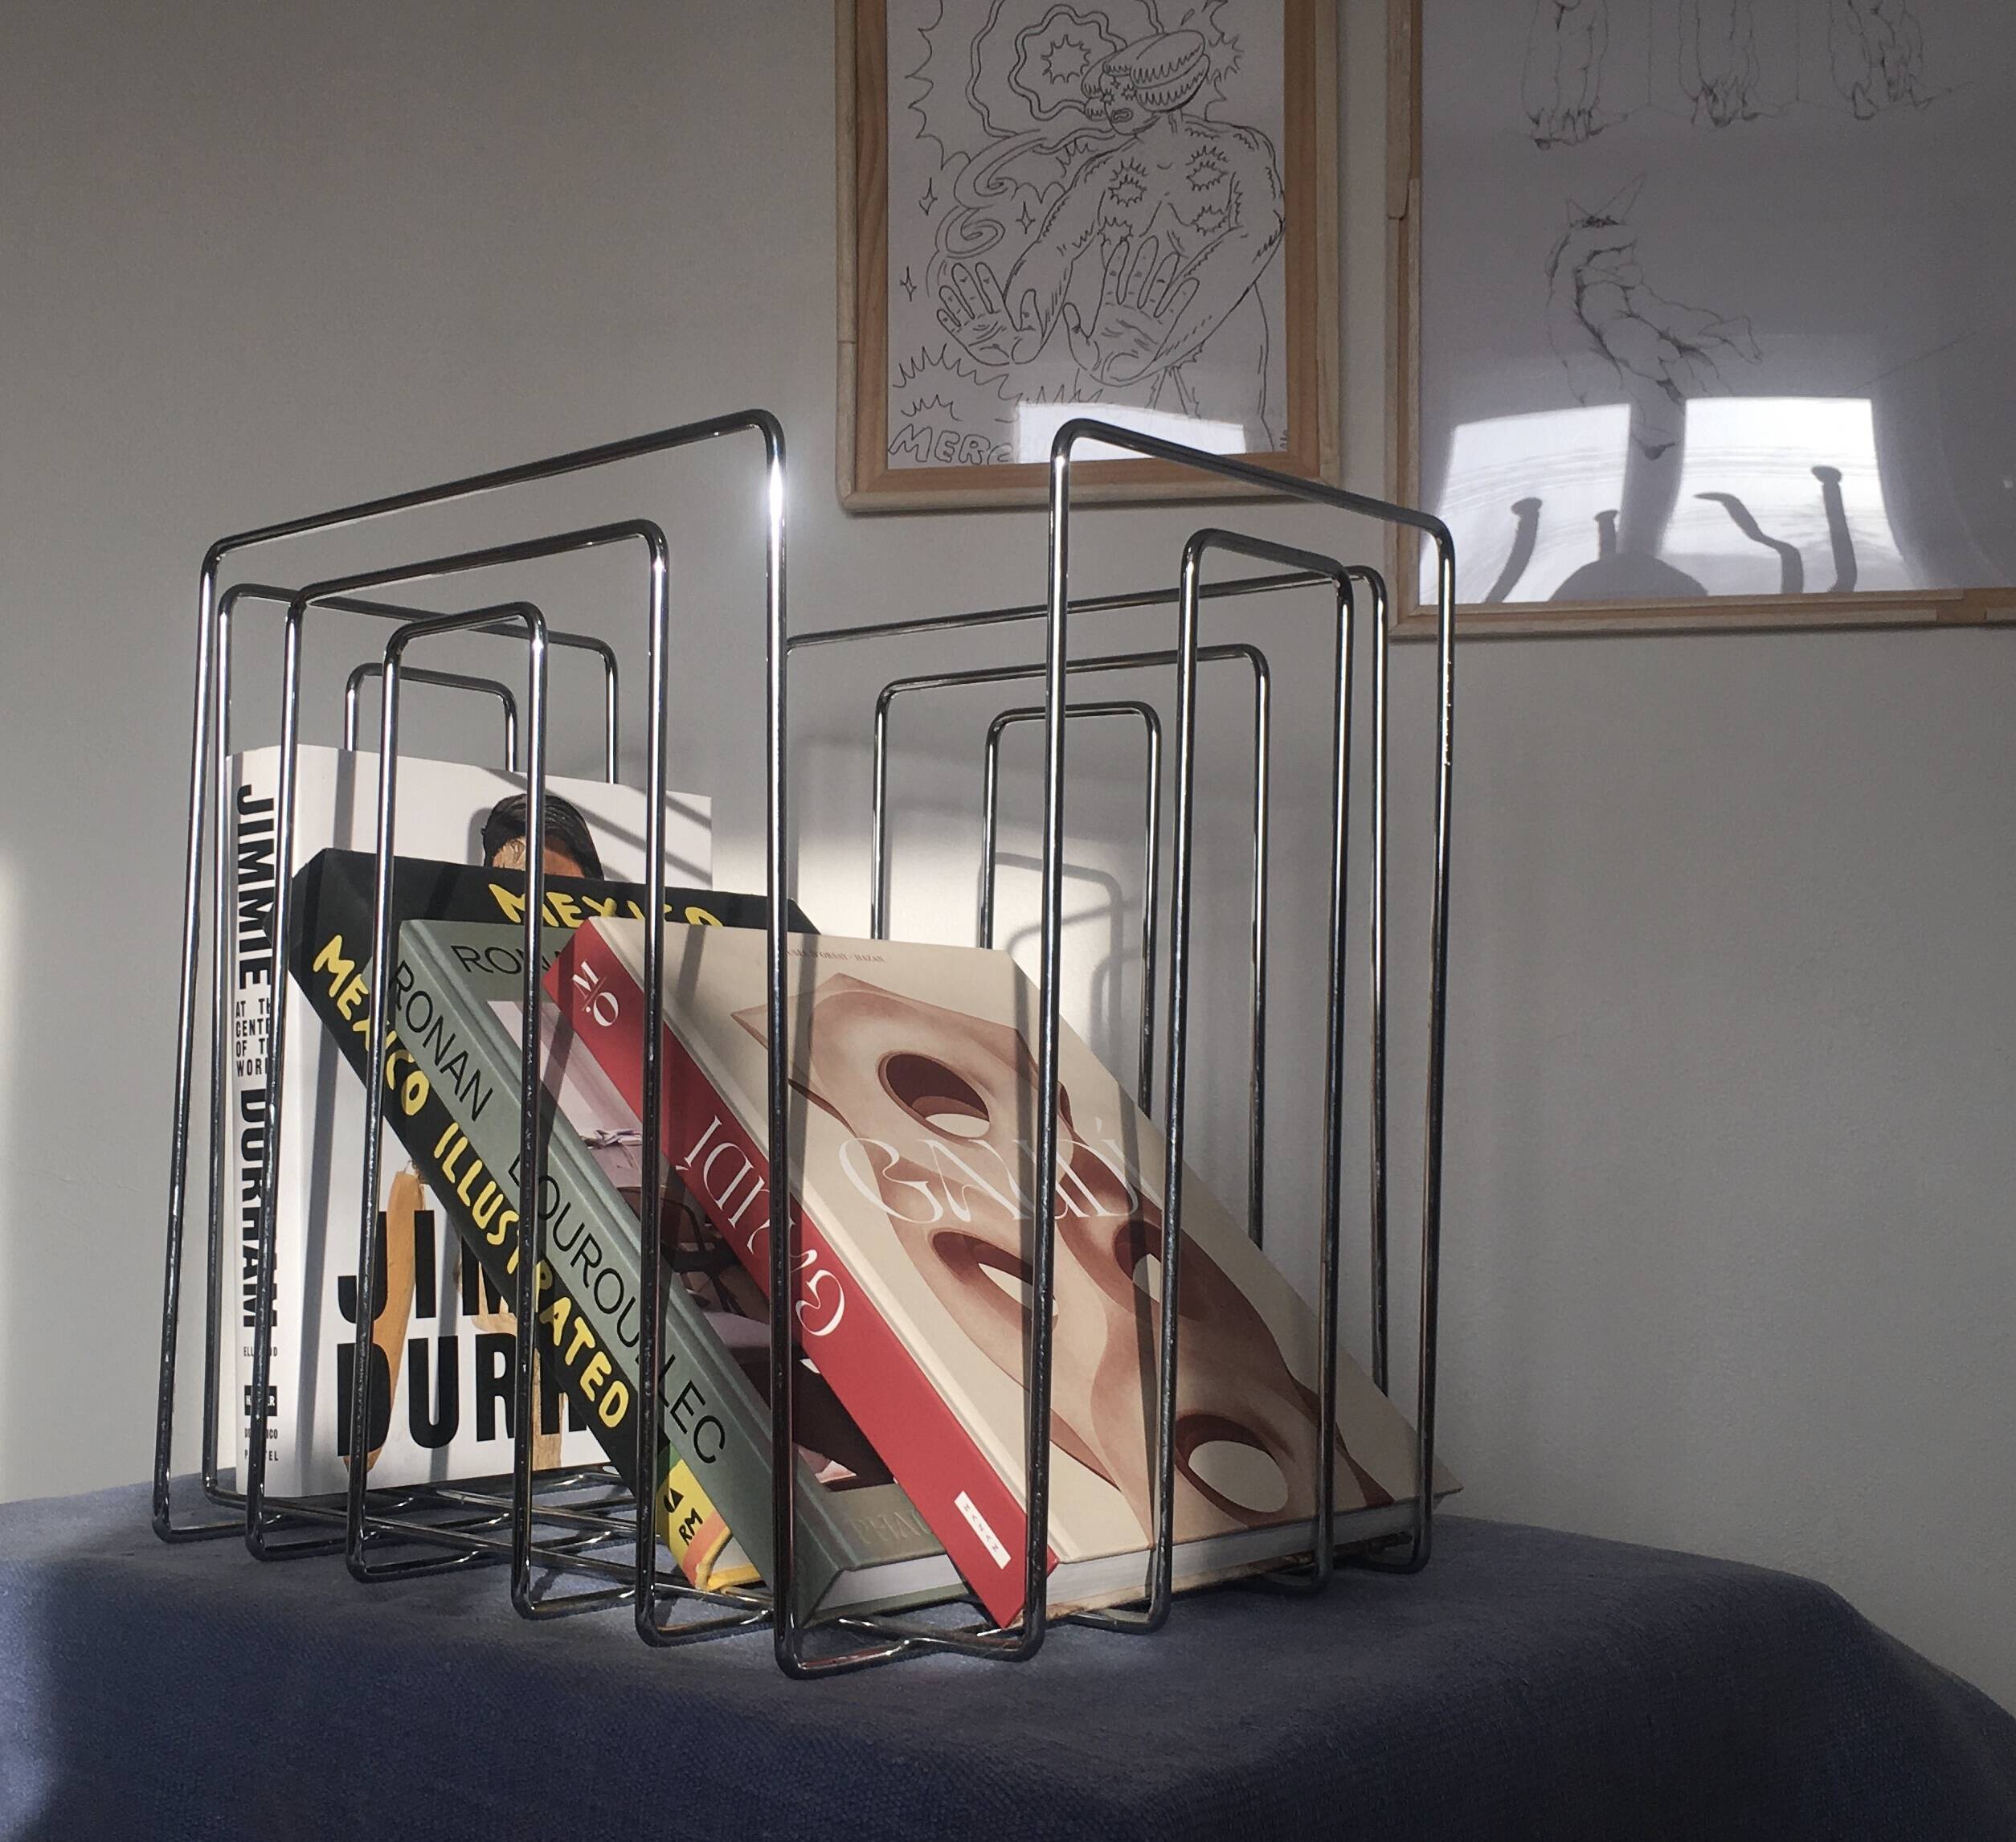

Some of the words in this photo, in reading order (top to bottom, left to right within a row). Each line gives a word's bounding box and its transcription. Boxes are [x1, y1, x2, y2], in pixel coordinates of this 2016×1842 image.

[237, 784, 274, 989] JIMMIE
[235, 1001, 246, 1018] AT
[235, 1040, 247, 1058] OF
[392, 960, 494, 1122] RONAN
[508, 1153, 726, 1464] OUROULEC
[678, 1506, 704, 1547] RM
